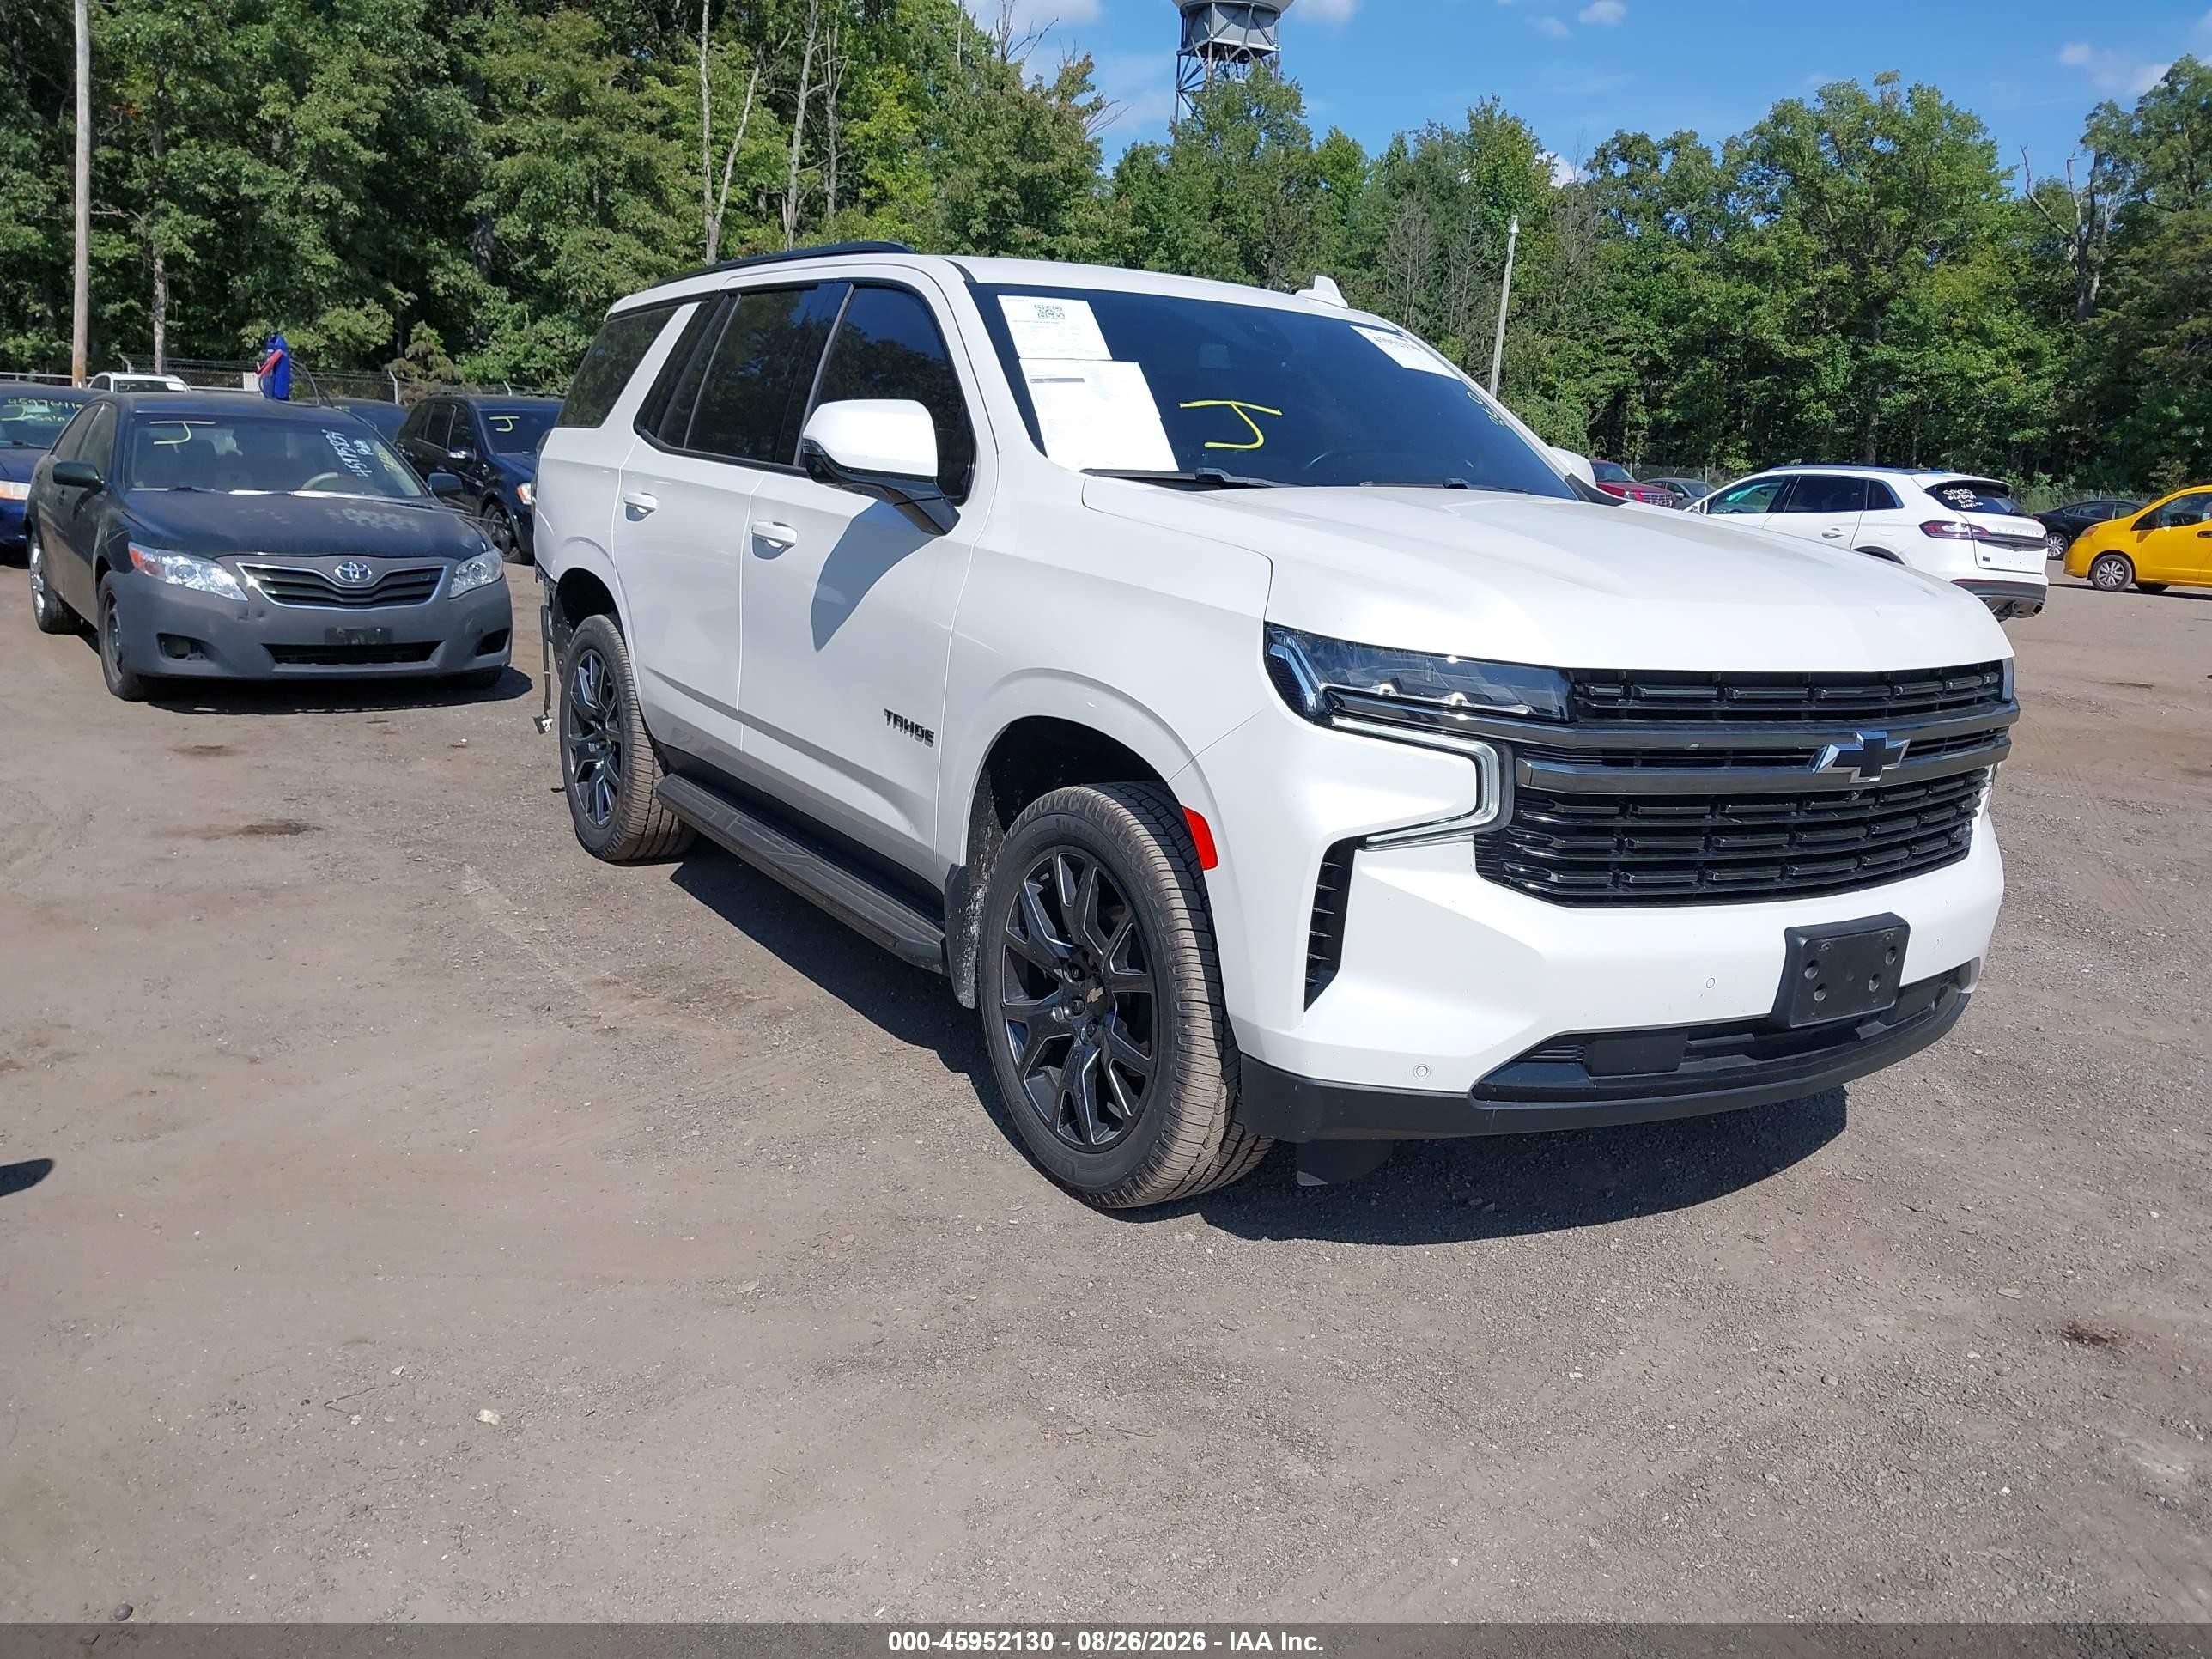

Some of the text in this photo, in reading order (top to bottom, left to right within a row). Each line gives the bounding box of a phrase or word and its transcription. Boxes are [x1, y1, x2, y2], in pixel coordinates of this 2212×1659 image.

[149, 421, 216, 445] J
[489, 416, 520, 432] J
[1177, 399, 1283, 449] J
[884, 708, 935, 749] TAHOE
